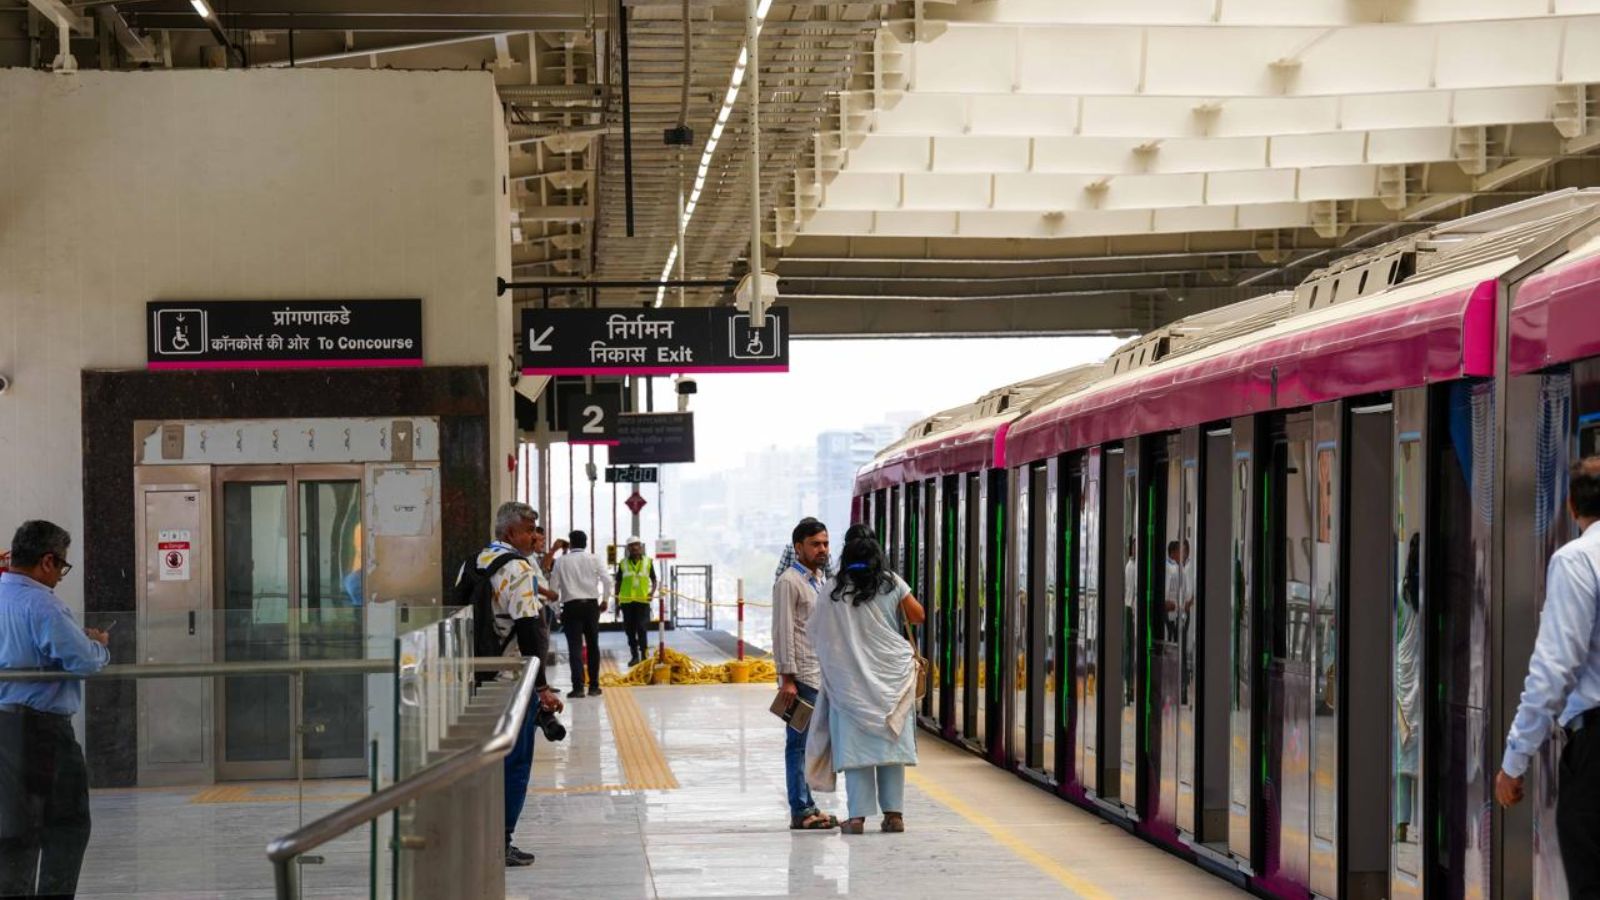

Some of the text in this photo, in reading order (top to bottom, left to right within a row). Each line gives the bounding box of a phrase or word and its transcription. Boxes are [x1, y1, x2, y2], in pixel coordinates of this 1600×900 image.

[272, 306, 351, 325] प्रांगणाकडे
[606, 314, 674, 339] निर्गमन
[211, 334, 310, 350] कॉनकोर्स की ओर
[317, 336, 413, 349] To Concourse
[590, 341, 647, 363] निकास
[657, 346, 693, 362] Exit
[582, 405, 605, 433] 2
[614, 469, 652, 481] 12:00
